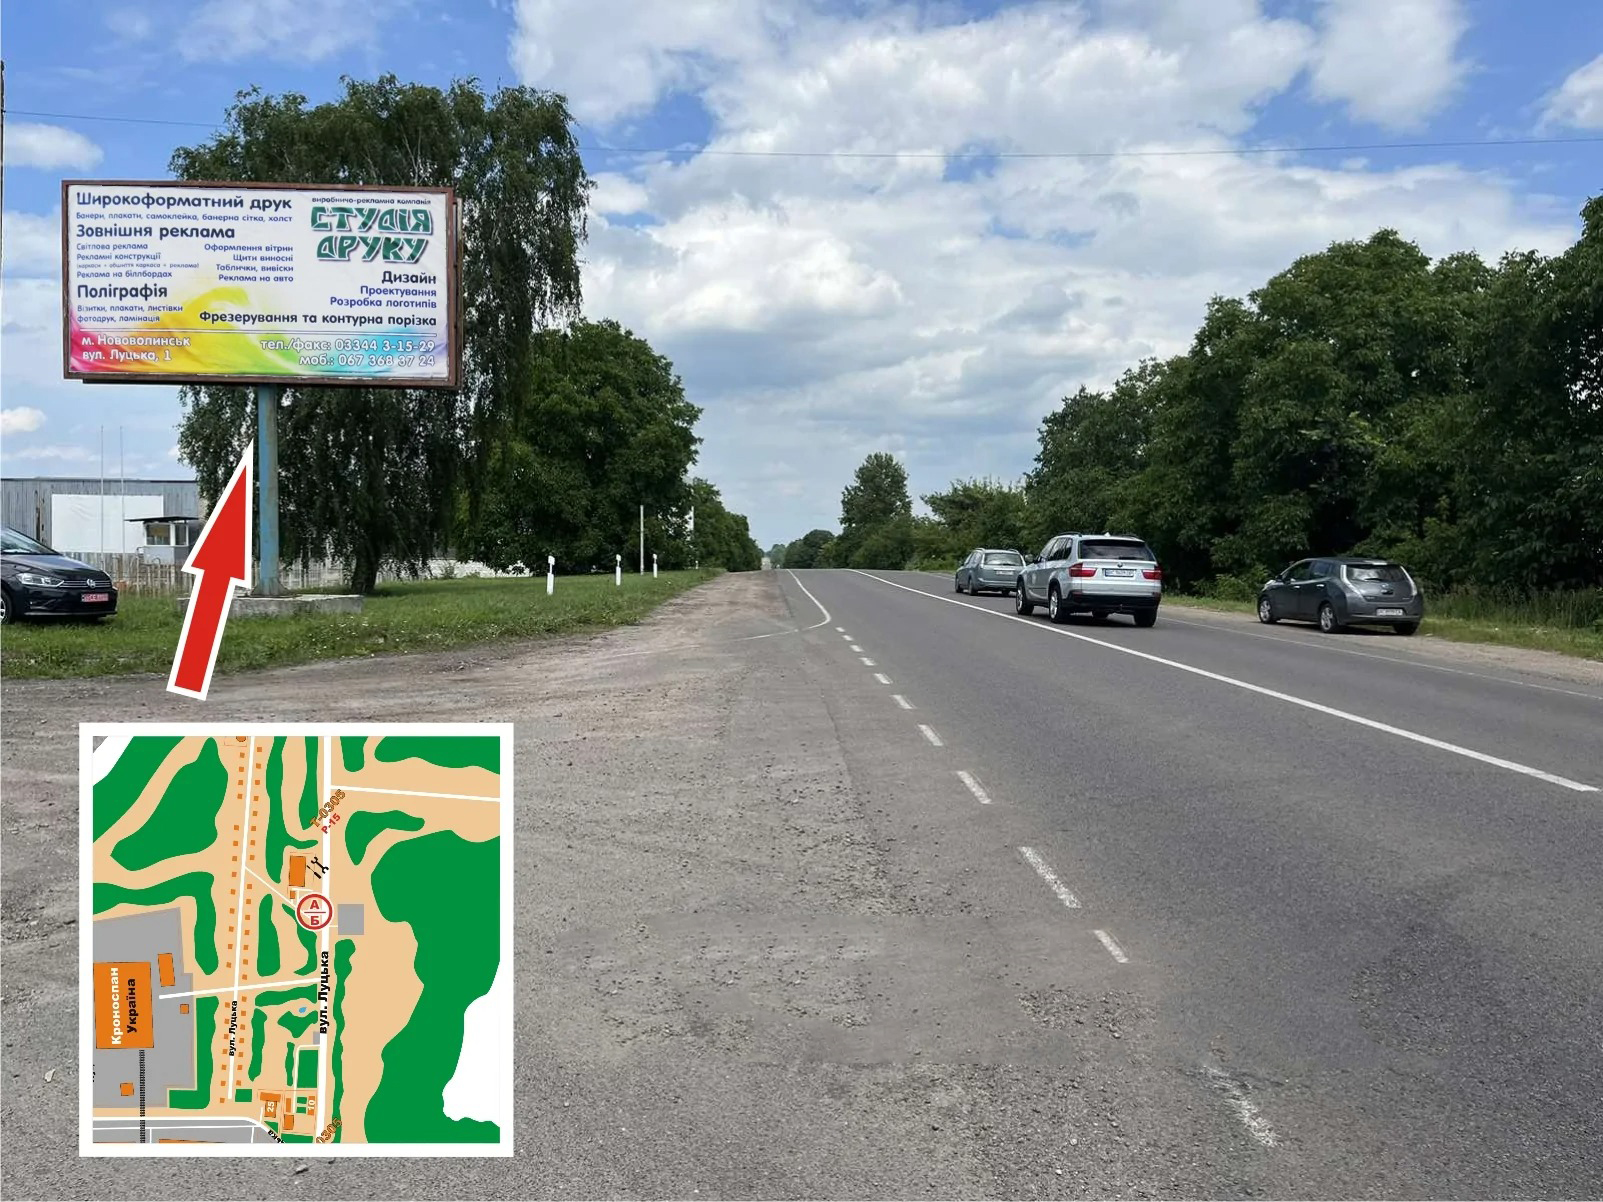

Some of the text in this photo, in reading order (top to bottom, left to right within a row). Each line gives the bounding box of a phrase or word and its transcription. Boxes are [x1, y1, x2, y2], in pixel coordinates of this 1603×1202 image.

[77, 192, 292, 212] Широкоформатний друк
[312, 197, 395, 205] виробничо-рекламна
[76, 212, 106, 221] Банери,
[108, 212, 143, 221] плакати,
[146, 212, 199, 222] самоклейка,
[202, 213, 239, 222] банерна
[242, 214, 266, 223] сітка,
[311, 206, 433, 235] СТУДІЯ
[76, 223, 235, 240] Зовнішня реклама
[76, 243, 148, 252] Світлова реклама
[204, 243, 293, 253] Оформлення вітрин
[317, 235, 428, 263] ДРУКУ
[76, 252, 161, 262] Рекламні конструкції
[233, 254, 293, 263] Щити виносні
[216, 264, 258, 273] Таблички,
[76, 270, 110, 278] Реклама
[125, 270, 172, 279] біллбордах
[218, 274, 257, 282] Реклама
[273, 275, 293, 283] авто
[382, 271, 437, 285] Дизайн
[77, 284, 168, 300] Поліграфія
[360, 286, 437, 297] Проектування
[77, 304, 183, 313] Візитки, плакати, листівки
[330, 297, 437, 309] Розробка логотипів
[77, 314, 160, 323] фотодрук, ламінація
[199, 311, 437, 327] Фрезерування та контурна порізка
[82, 334, 190, 347] м. Нововолинськ
[261, 337, 435, 353] тел./факс: 03344 3-15-29
[82, 349, 172, 363] вул. Луцька, 1
[299, 354, 435, 367] моб.: 067 368 37 24
